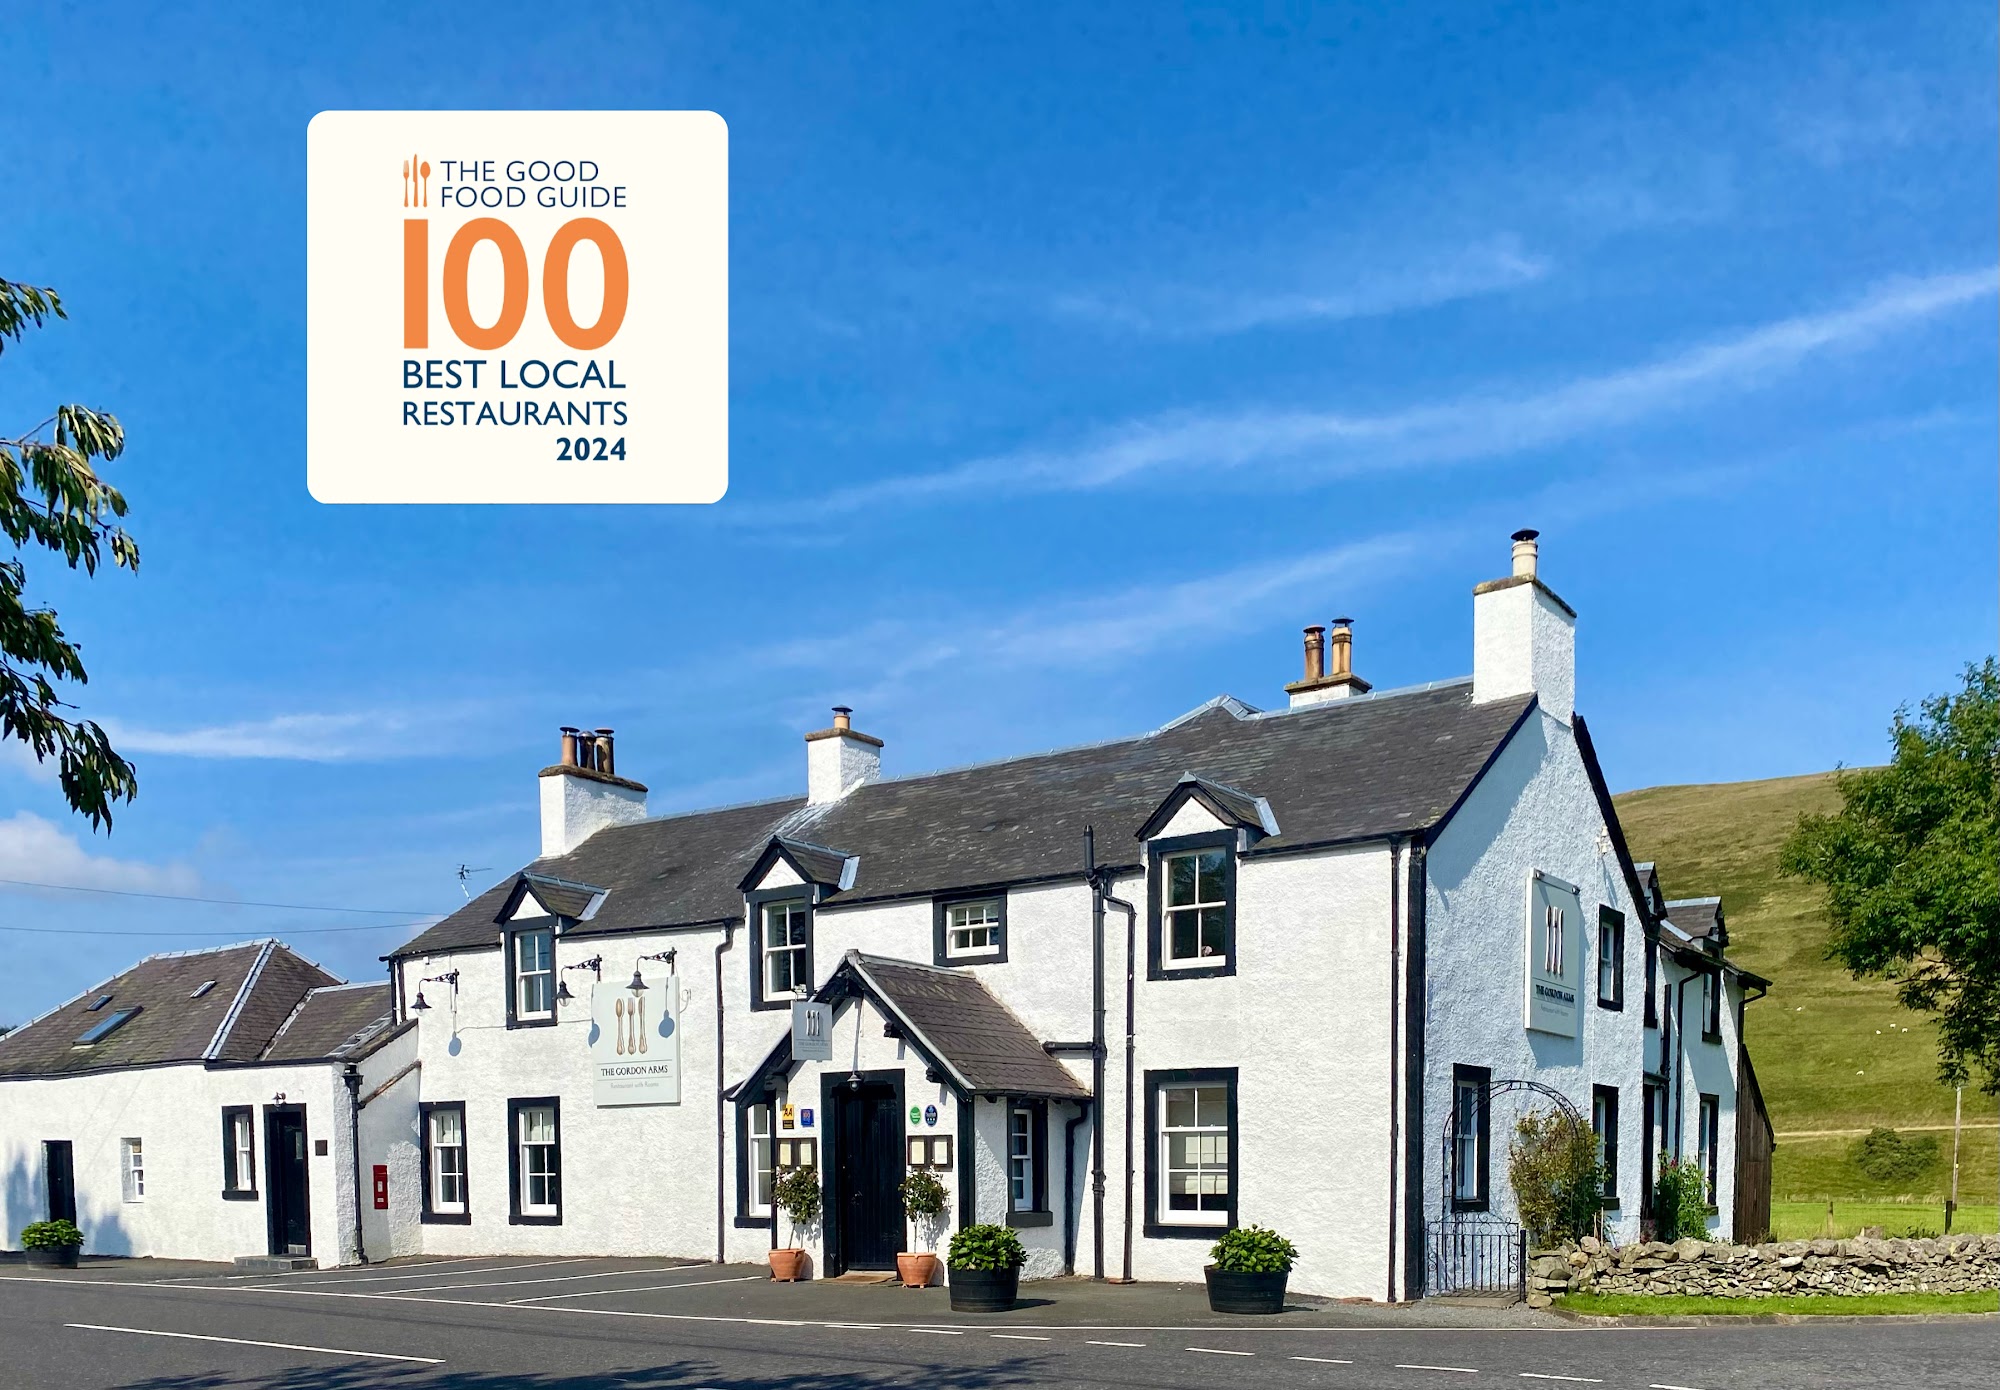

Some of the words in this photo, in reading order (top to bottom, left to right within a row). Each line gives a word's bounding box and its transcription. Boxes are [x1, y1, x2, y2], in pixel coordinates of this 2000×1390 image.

[601, 1068, 615, 1076] THE
[616, 1066, 646, 1075] GORDON
[648, 1065, 668, 1074] ARMS
